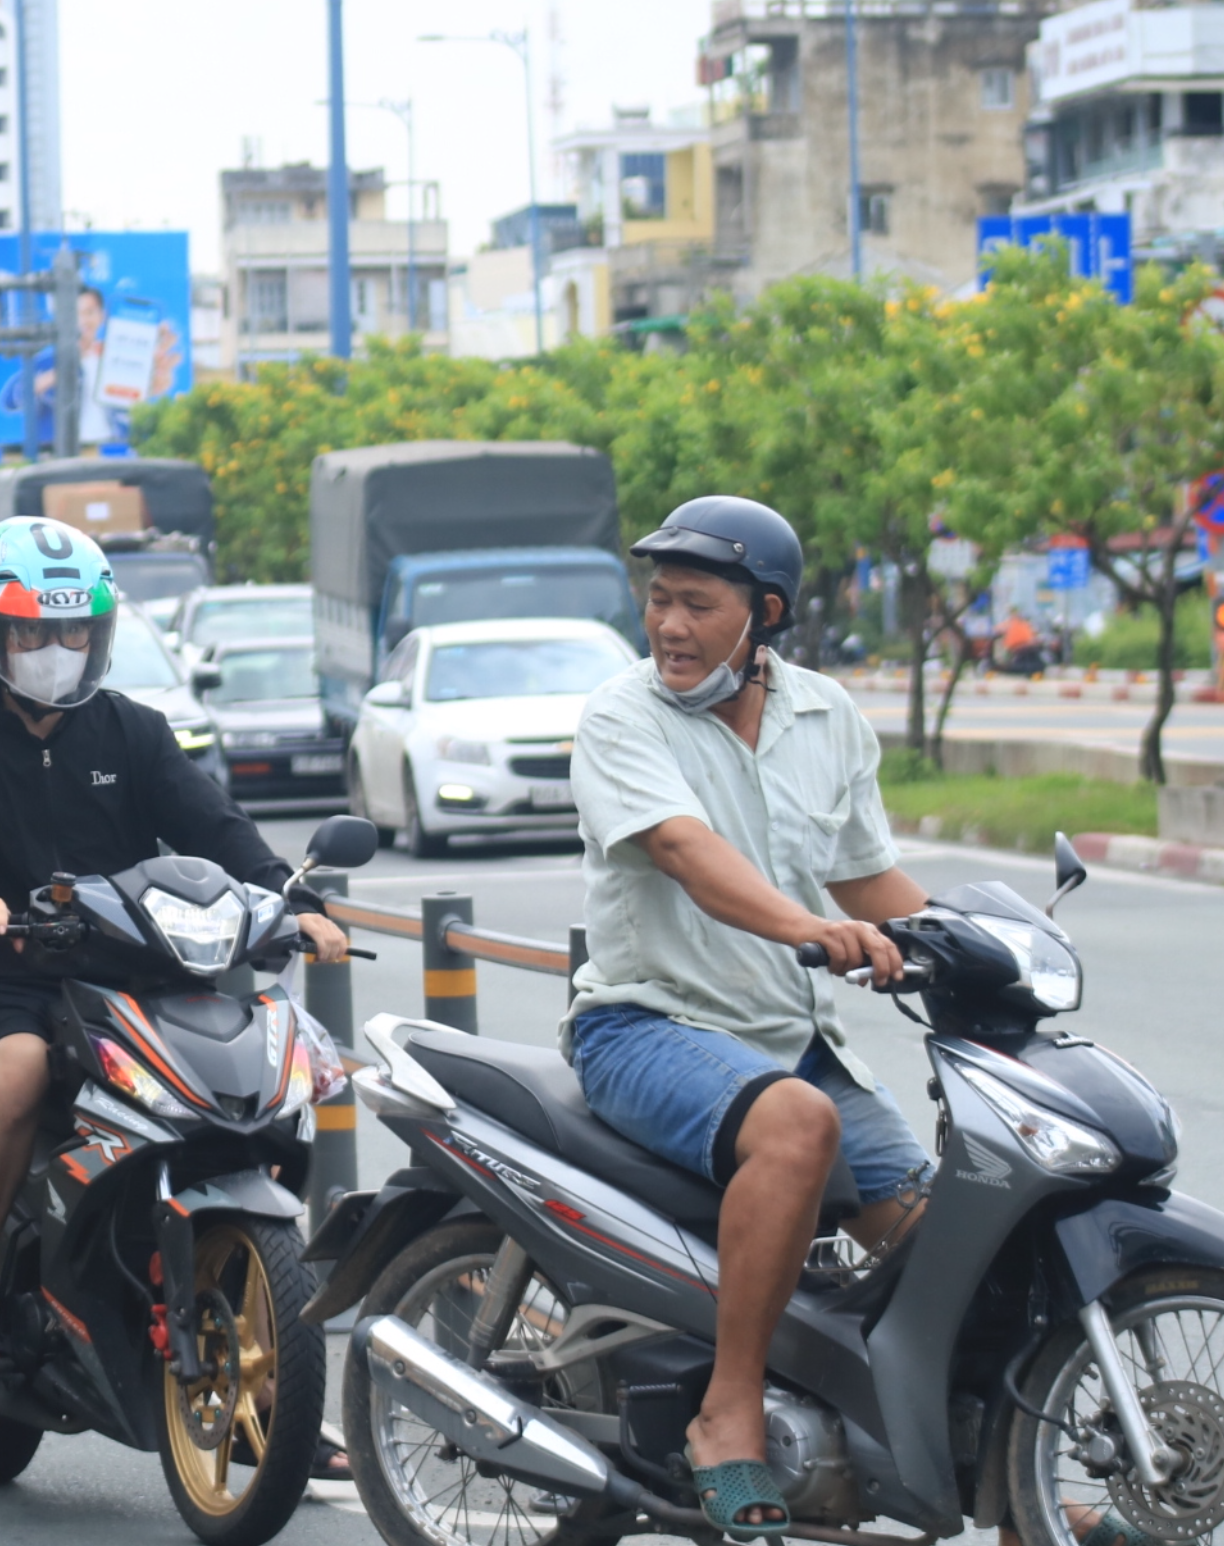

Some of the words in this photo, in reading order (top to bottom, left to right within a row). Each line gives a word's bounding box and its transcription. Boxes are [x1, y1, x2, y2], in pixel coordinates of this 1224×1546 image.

[38, 589, 92, 606] KYT
[90, 770, 116, 785] Dior
[97, 1097, 148, 1130] Racing
[955, 1169, 1011, 1189] HONDA
